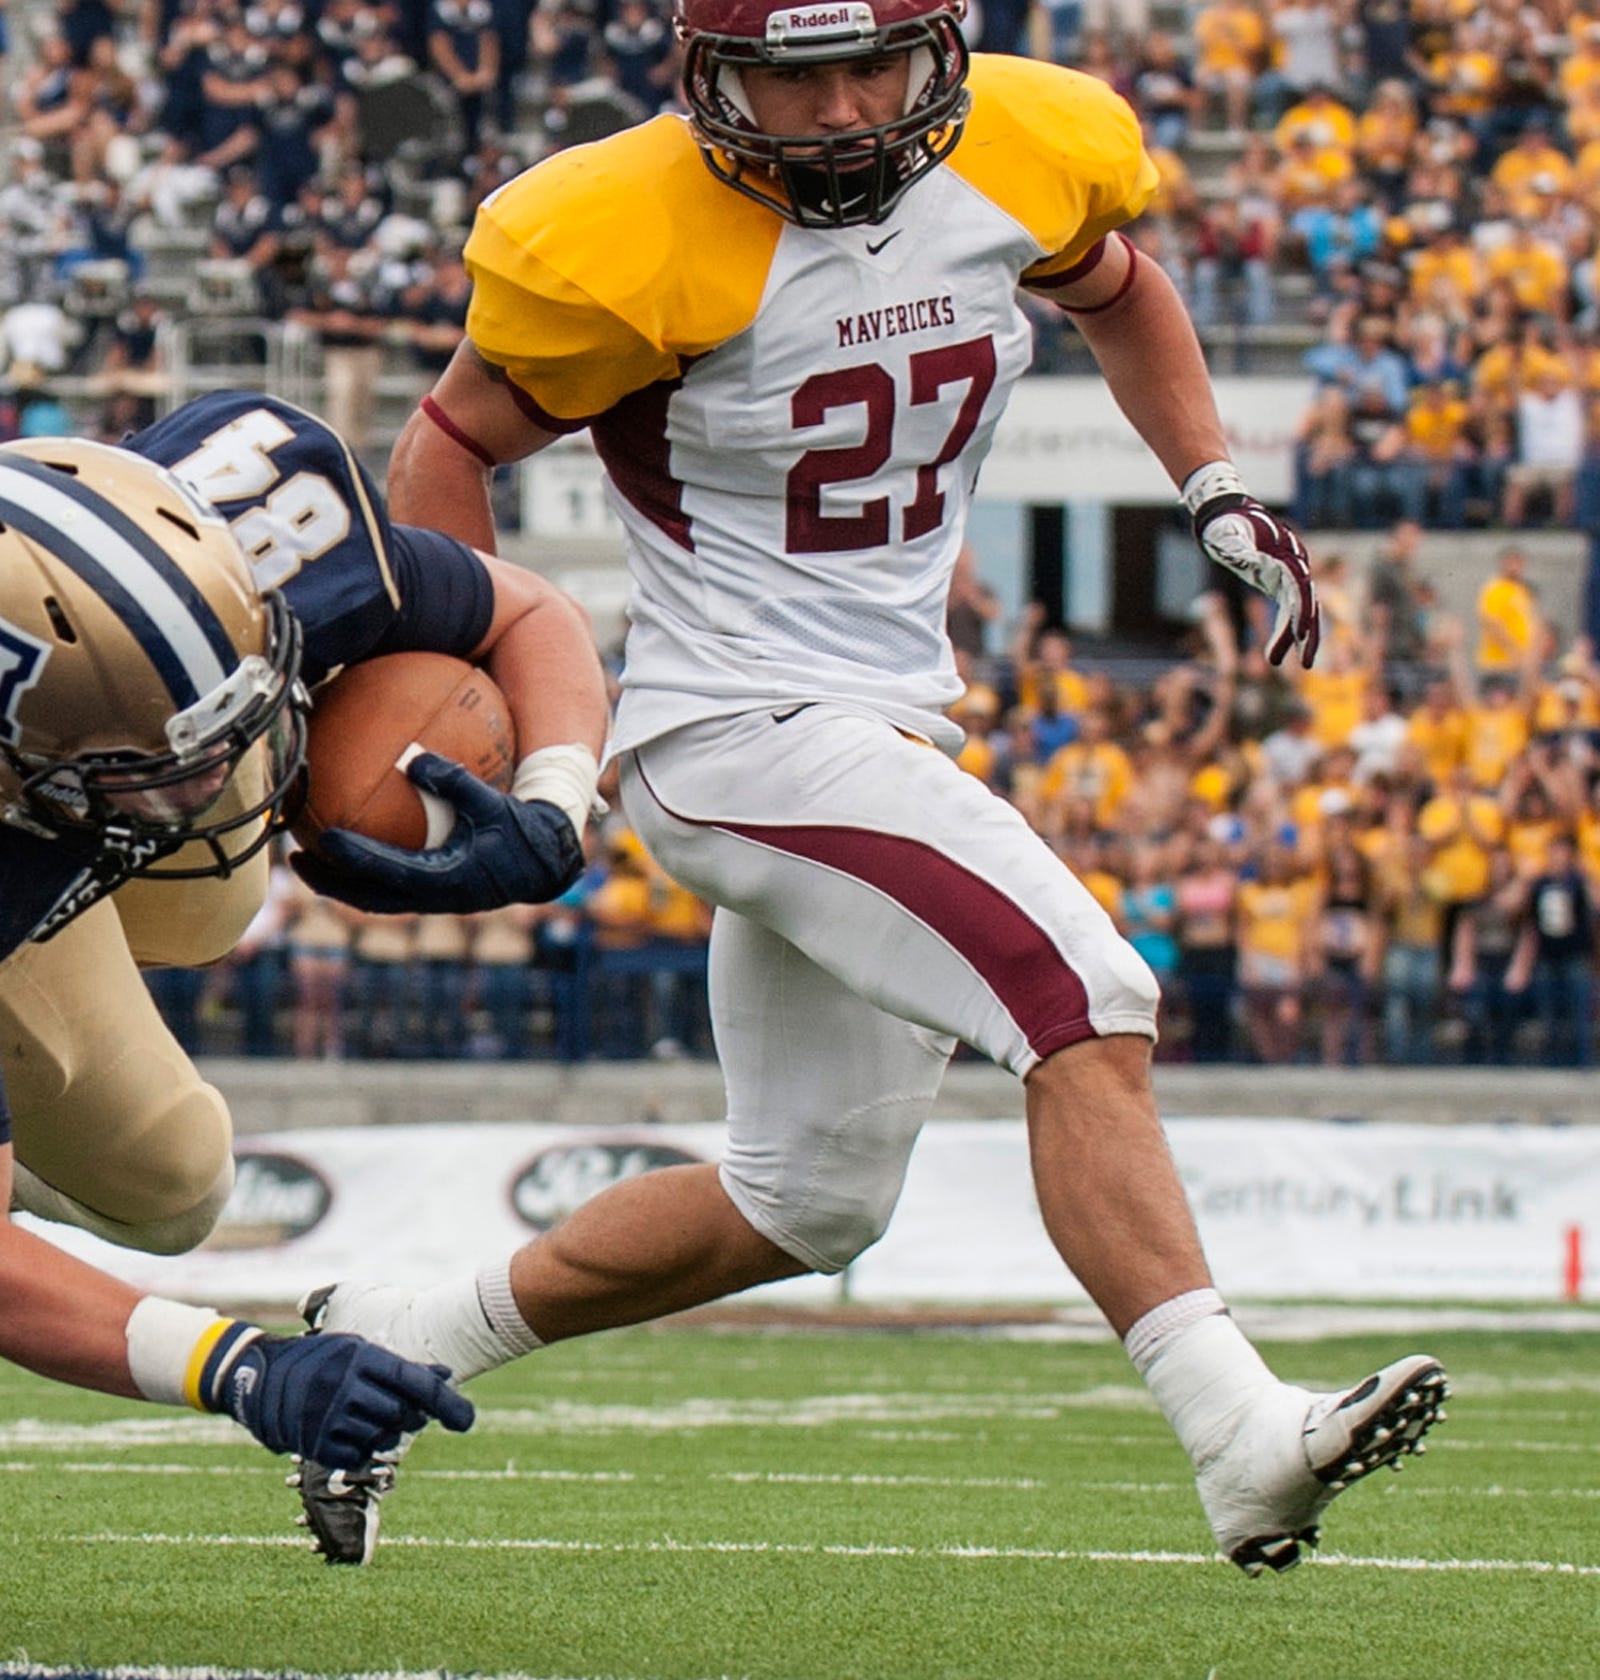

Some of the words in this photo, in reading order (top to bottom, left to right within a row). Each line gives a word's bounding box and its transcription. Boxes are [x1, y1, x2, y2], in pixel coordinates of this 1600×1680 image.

[790, 8, 849, 28] Riddell
[836, 295, 955, 348] MAVERICKS
[785, 333, 997, 554] 27
[167, 408, 351, 593] 84
[1184, 1167, 1521, 1227] enturyLink
